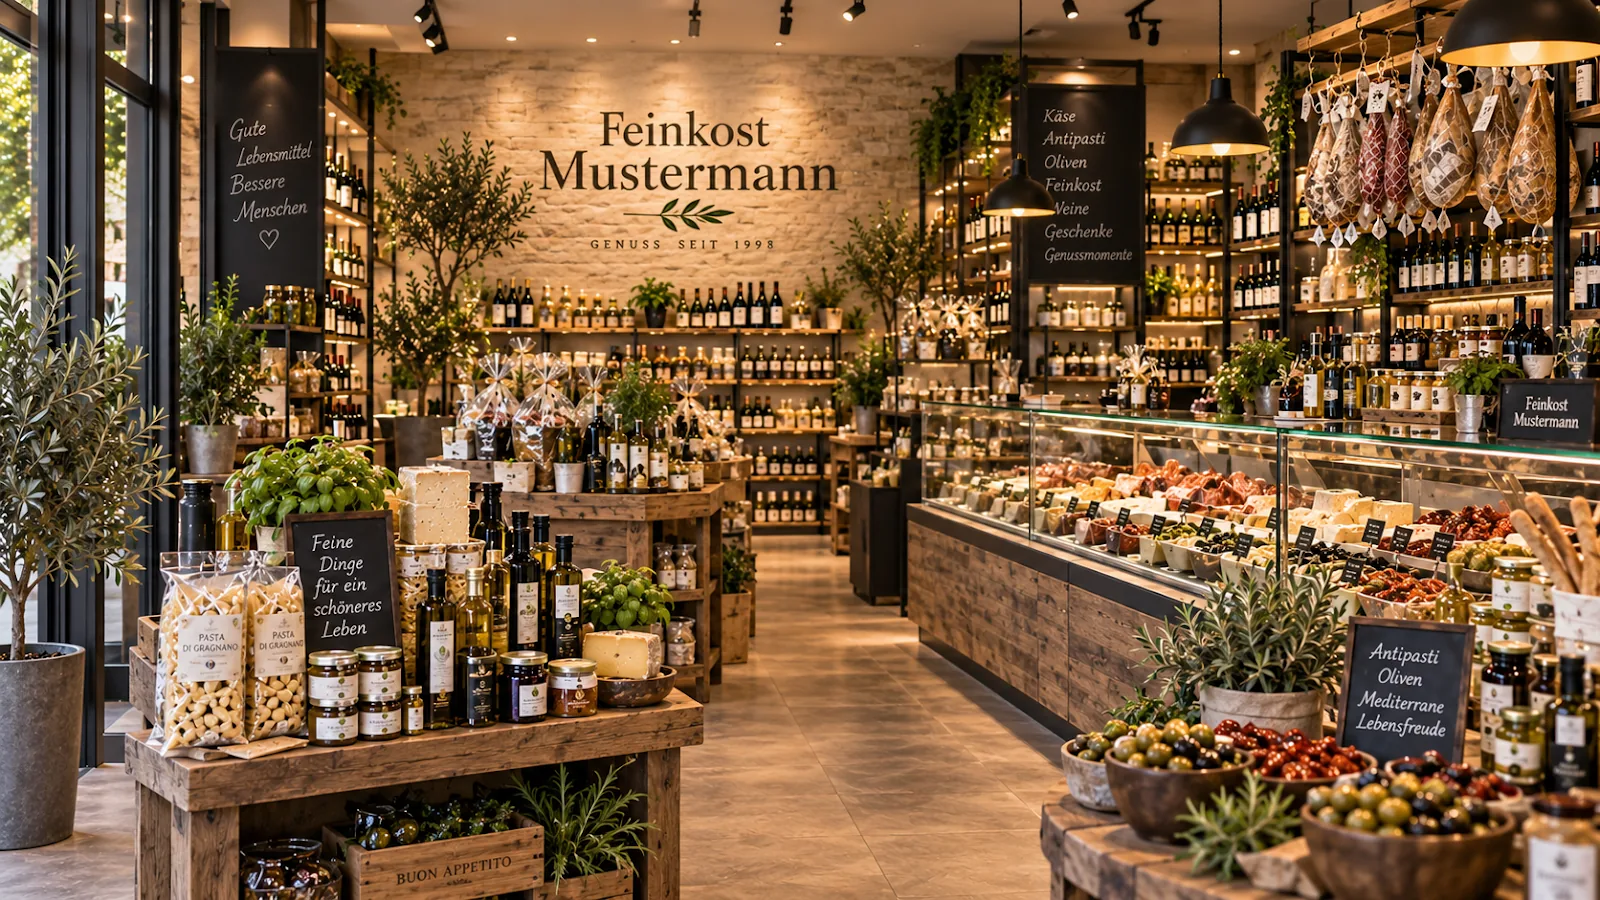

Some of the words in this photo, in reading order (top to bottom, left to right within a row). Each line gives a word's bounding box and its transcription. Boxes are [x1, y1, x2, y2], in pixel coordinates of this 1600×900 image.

[1043, 108, 1076, 123] Käse
[229, 117, 267, 142] Gute
[599, 110, 770, 147] Feinkost
[1042, 131, 1106, 149] Antipasti
[236, 140, 313, 167] Lebensmittel
[1044, 154, 1088, 169] Oliven
[538, 150, 839, 191] Mustermann
[229, 173, 286, 195] Bessere
[1045, 177, 1102, 192] Feinkost
[232, 197, 308, 223] Menschen
[1044, 223, 1114, 241] Geschenke
[590, 239, 661, 250] GENUSS
[678, 239, 718, 250] SEIT
[734, 239, 775, 250] 1998
[1044, 247, 1133, 264] Genussmomente
[1525, 396, 1569, 411] Feinkost
[1513, 412, 1580, 429] Mustermann
[312, 533, 354, 552] Feine
[319, 556, 364, 576] Dinge
[313, 577, 339, 600] für
[343, 577, 367, 592] ein
[313, 598, 382, 617] schöneres
[198, 633, 225, 642] PASTA
[272, 630, 295, 639] PASTA
[320, 619, 368, 638] Leben
[182, 644, 192, 652] DI
[193, 643, 239, 652] GRAGNANO
[259, 642, 268, 651] DI
[1368, 642, 1440, 667] Antipasti
[1378, 667, 1423, 687] Oliven
[1356, 690, 1445, 714] Mediterrane
[1355, 712, 1446, 738] Lebensfreude
[396, 868, 438, 885] BUON
[443, 856, 512, 877] APPETITO
